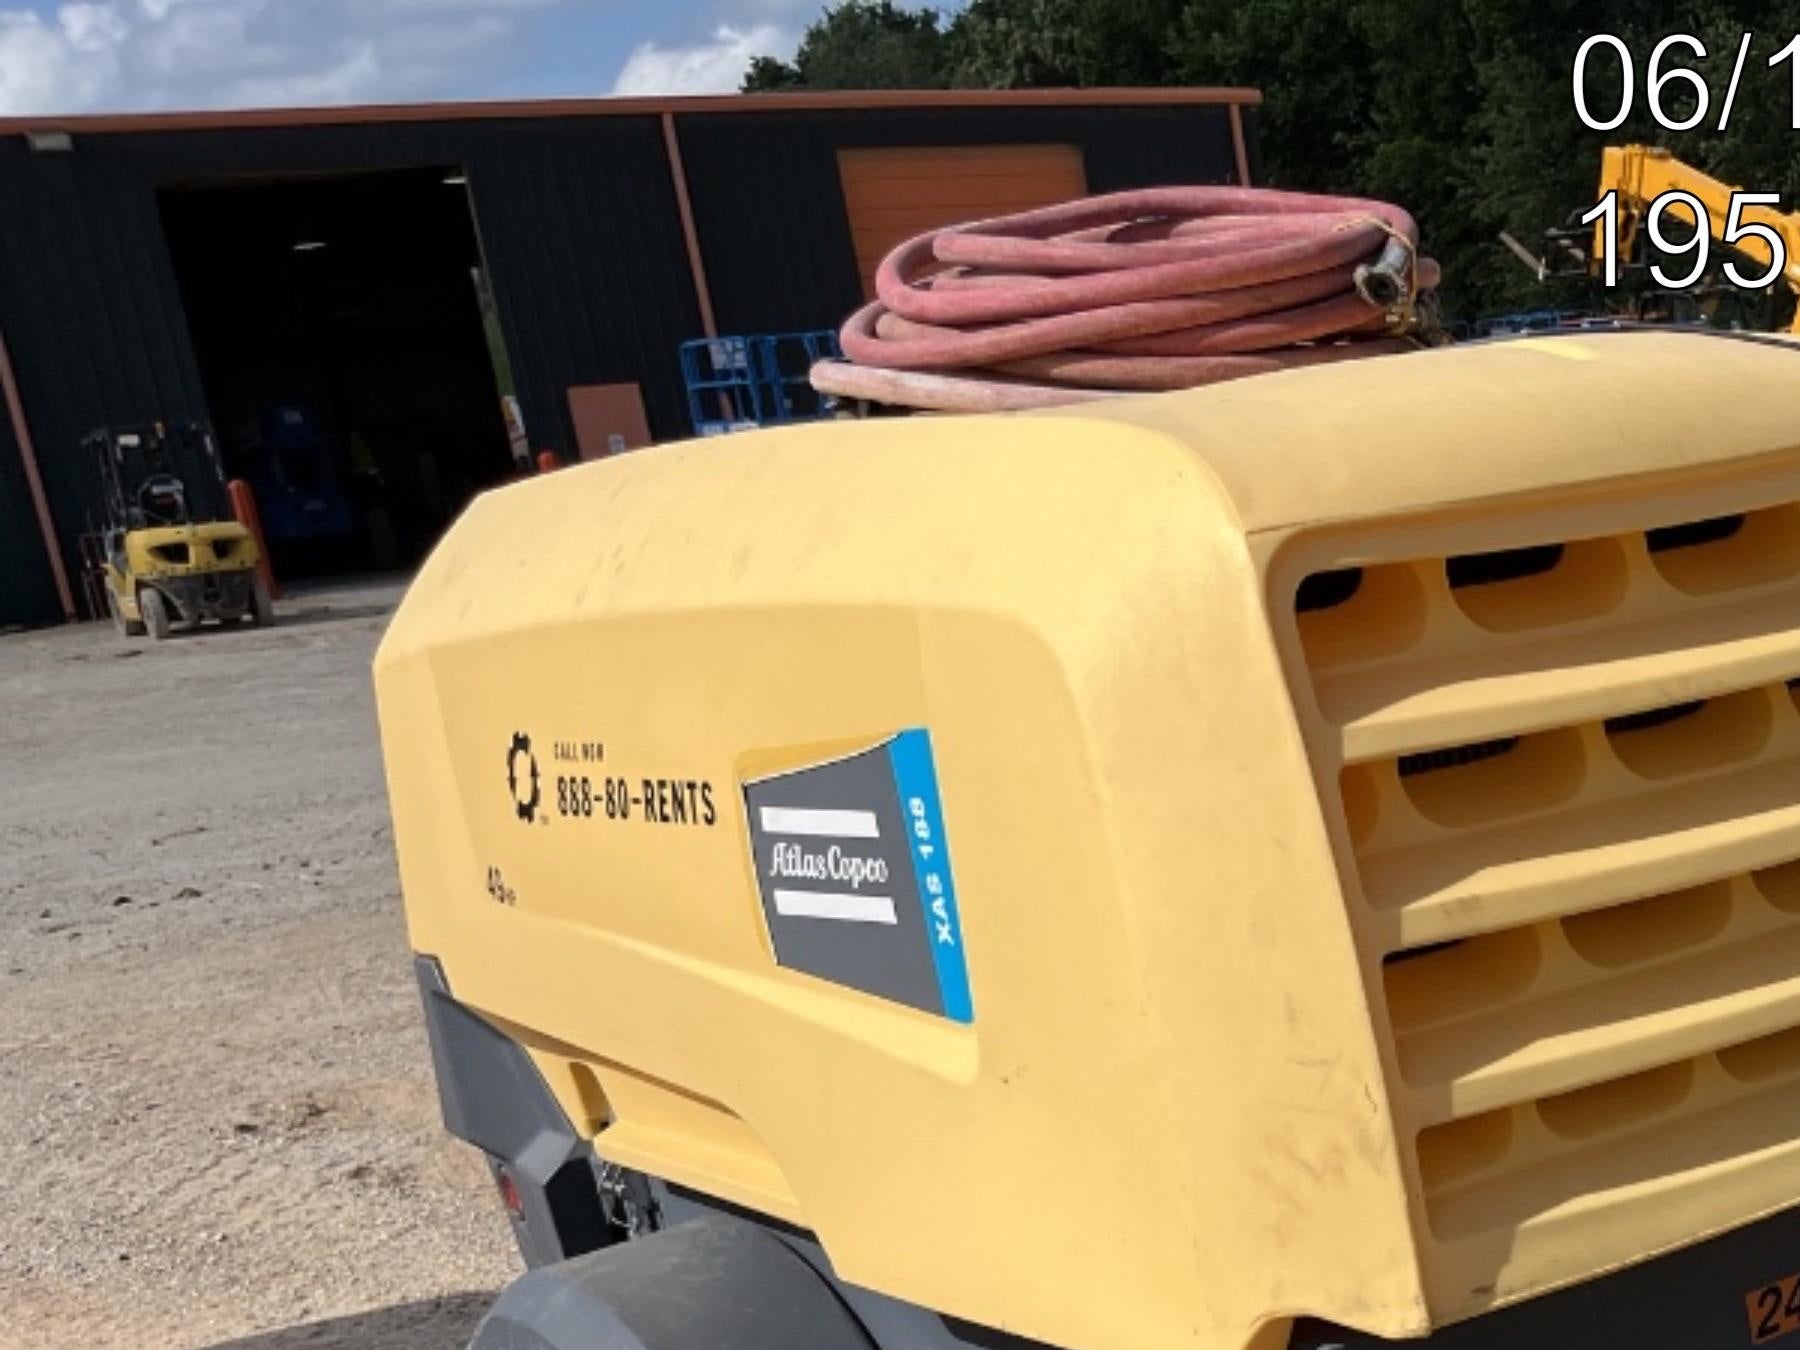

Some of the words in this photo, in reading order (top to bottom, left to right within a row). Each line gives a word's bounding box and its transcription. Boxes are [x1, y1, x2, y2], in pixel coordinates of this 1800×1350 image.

[557, 775, 717, 826] 888-80-RENTS
[907, 796, 935, 861] 188
[925, 872, 955, 946] XAS
